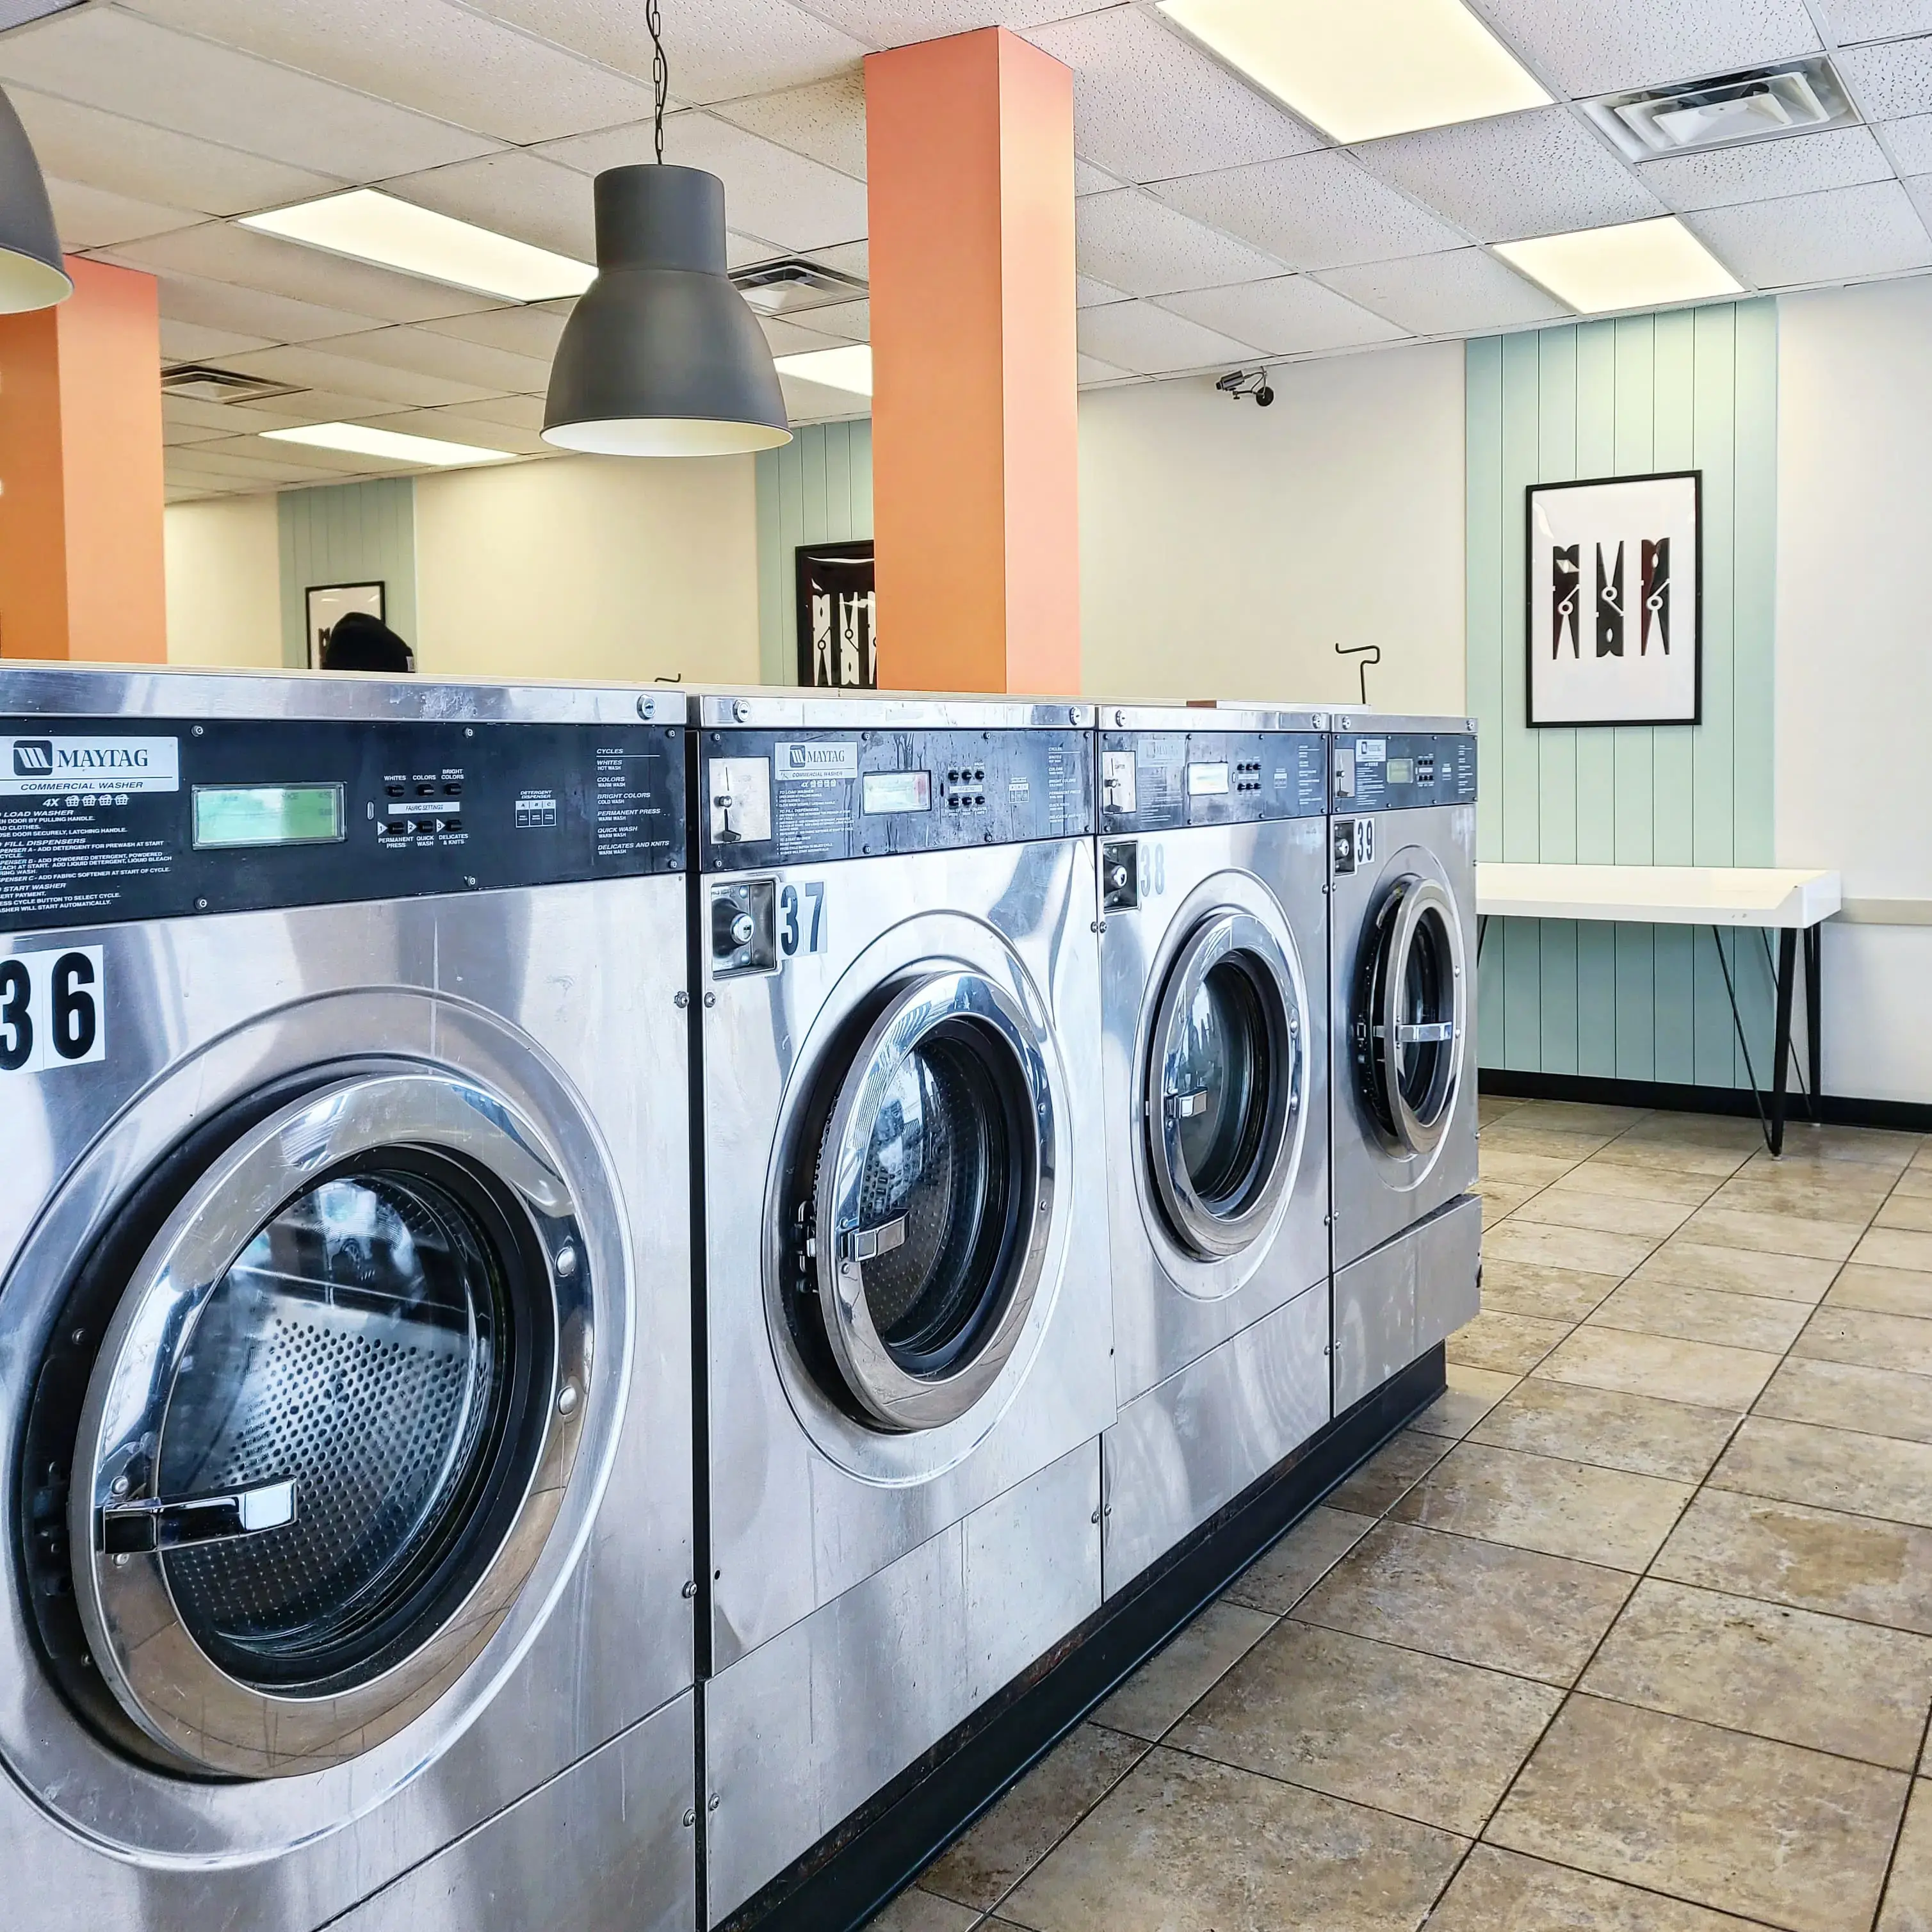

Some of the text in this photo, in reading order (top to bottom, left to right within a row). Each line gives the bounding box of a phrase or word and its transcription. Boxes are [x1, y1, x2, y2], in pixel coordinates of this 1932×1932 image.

[57, 749, 148, 767] MAYTAG
[808, 750, 845, 763] MAYTAG
[20, 781, 143, 791] COMMERCIAL WASHER
[42, 798, 60, 807] 4X
[1358, 820, 1372, 863] 39
[1141, 843, 1165, 897] 38
[781, 881, 824, 955] 37
[0, 952, 95, 1071] 36
